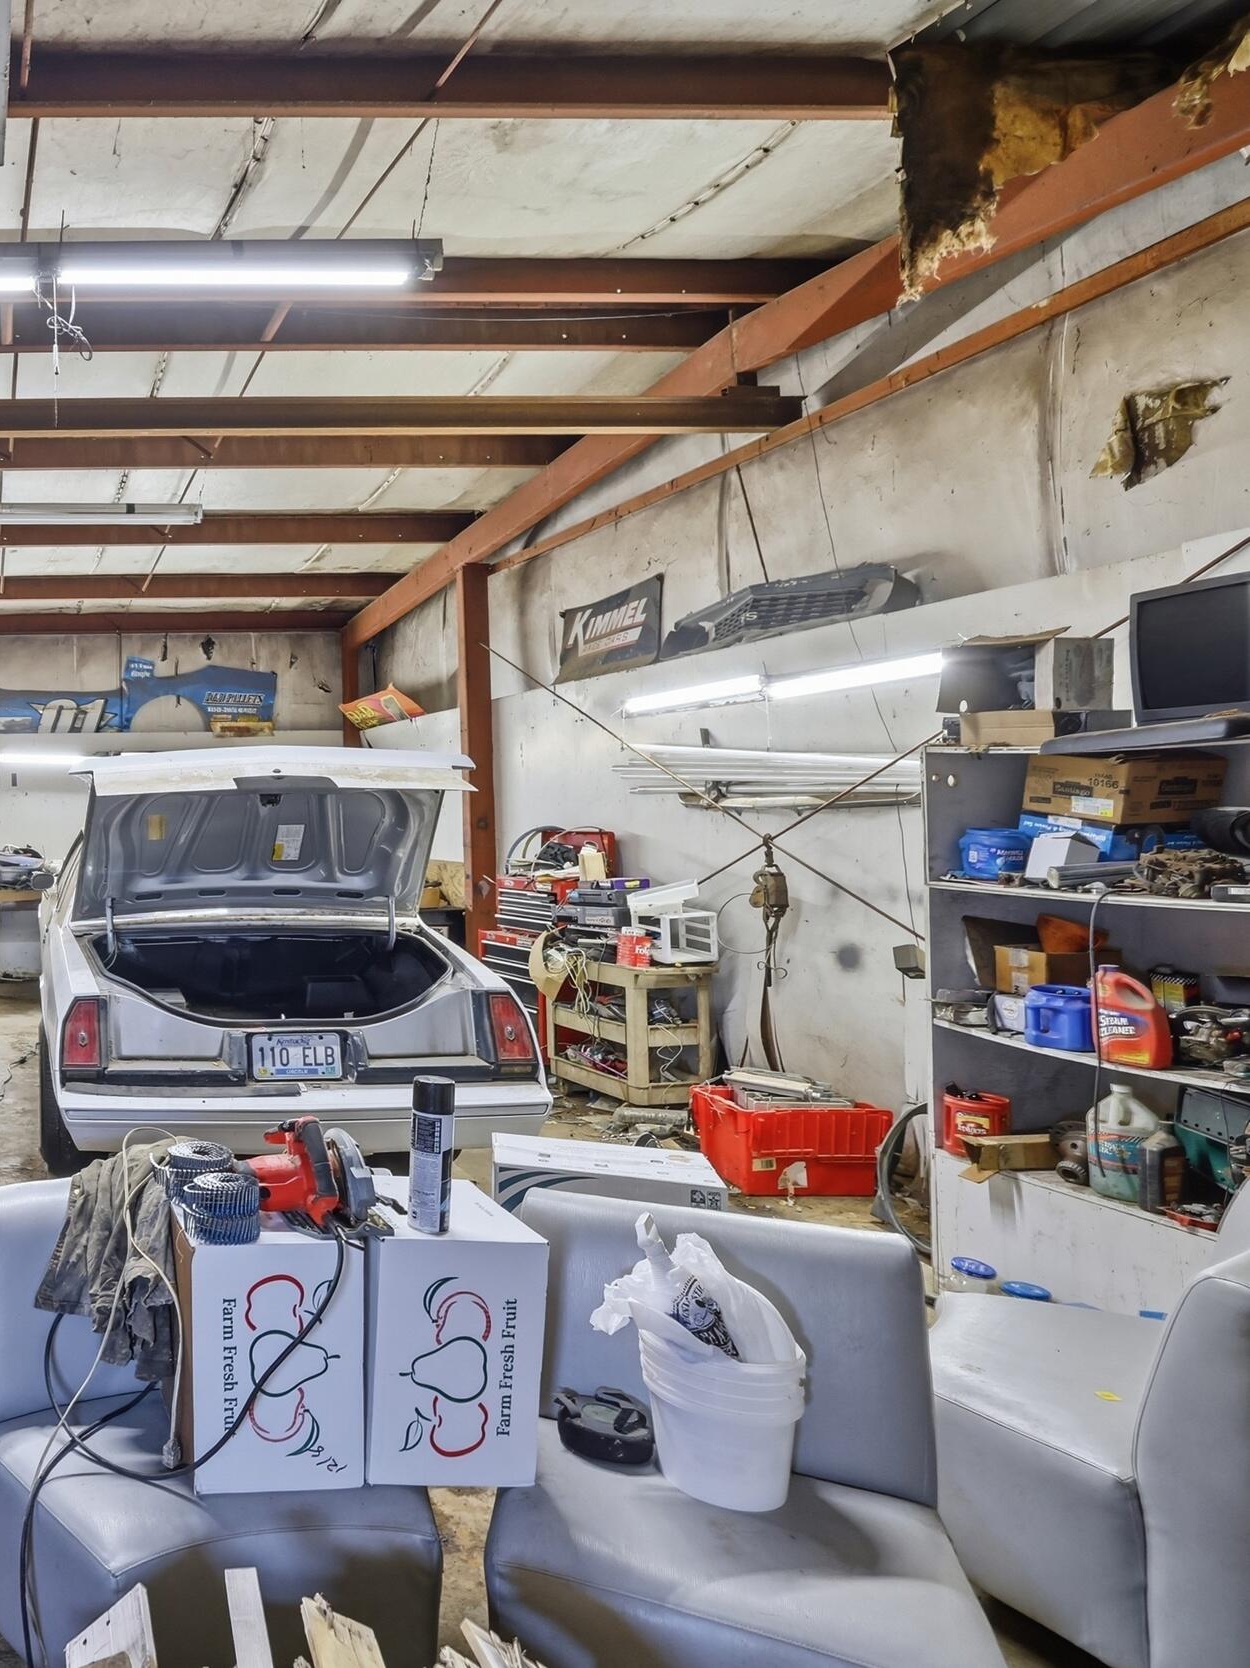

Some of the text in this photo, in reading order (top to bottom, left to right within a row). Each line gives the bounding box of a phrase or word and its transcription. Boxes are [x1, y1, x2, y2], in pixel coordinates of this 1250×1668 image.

[567, 597, 648, 656] KIMMEL
[1087, 777, 1119, 790] 10166
[258, 1046, 335, 1067] 110 ELB
[223, 1298, 238, 1437] Farm Fresh Fru
[496, 1297, 518, 1437] Farm Fresh Fruit
